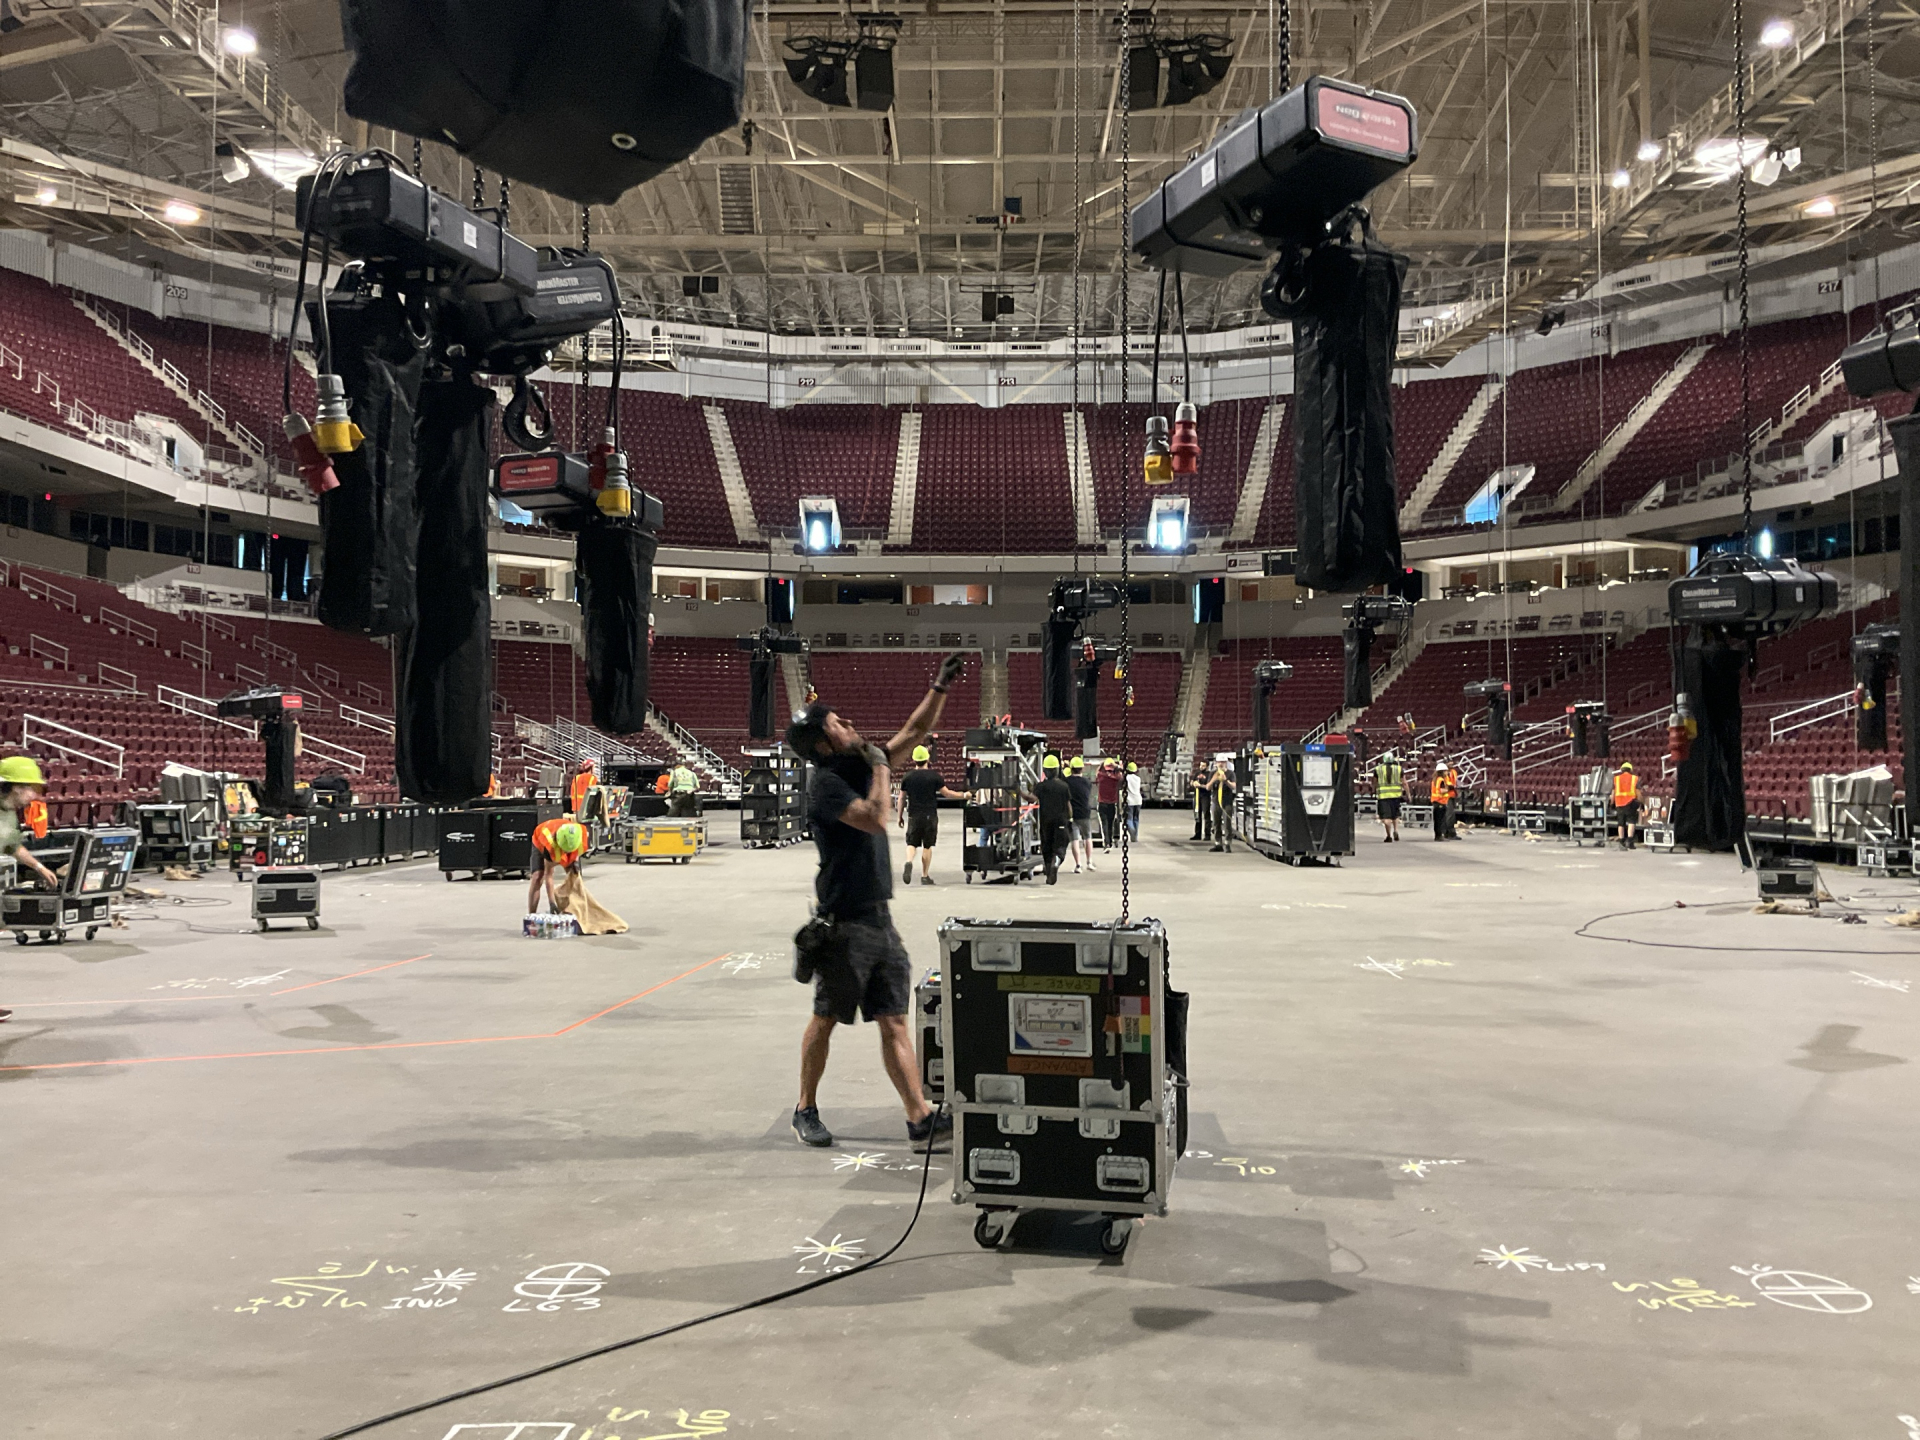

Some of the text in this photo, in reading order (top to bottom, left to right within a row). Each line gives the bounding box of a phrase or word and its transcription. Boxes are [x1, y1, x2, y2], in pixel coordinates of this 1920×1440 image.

[166, 286, 188, 299] 209
[1819, 281, 1840, 294] 217
[800, 378, 815, 386] 212
[1000, 378, 1016, 386] 213
[1049, 978, 1093, 991] SPARE
[1024, 1060, 1089, 1071] ADVANCE
